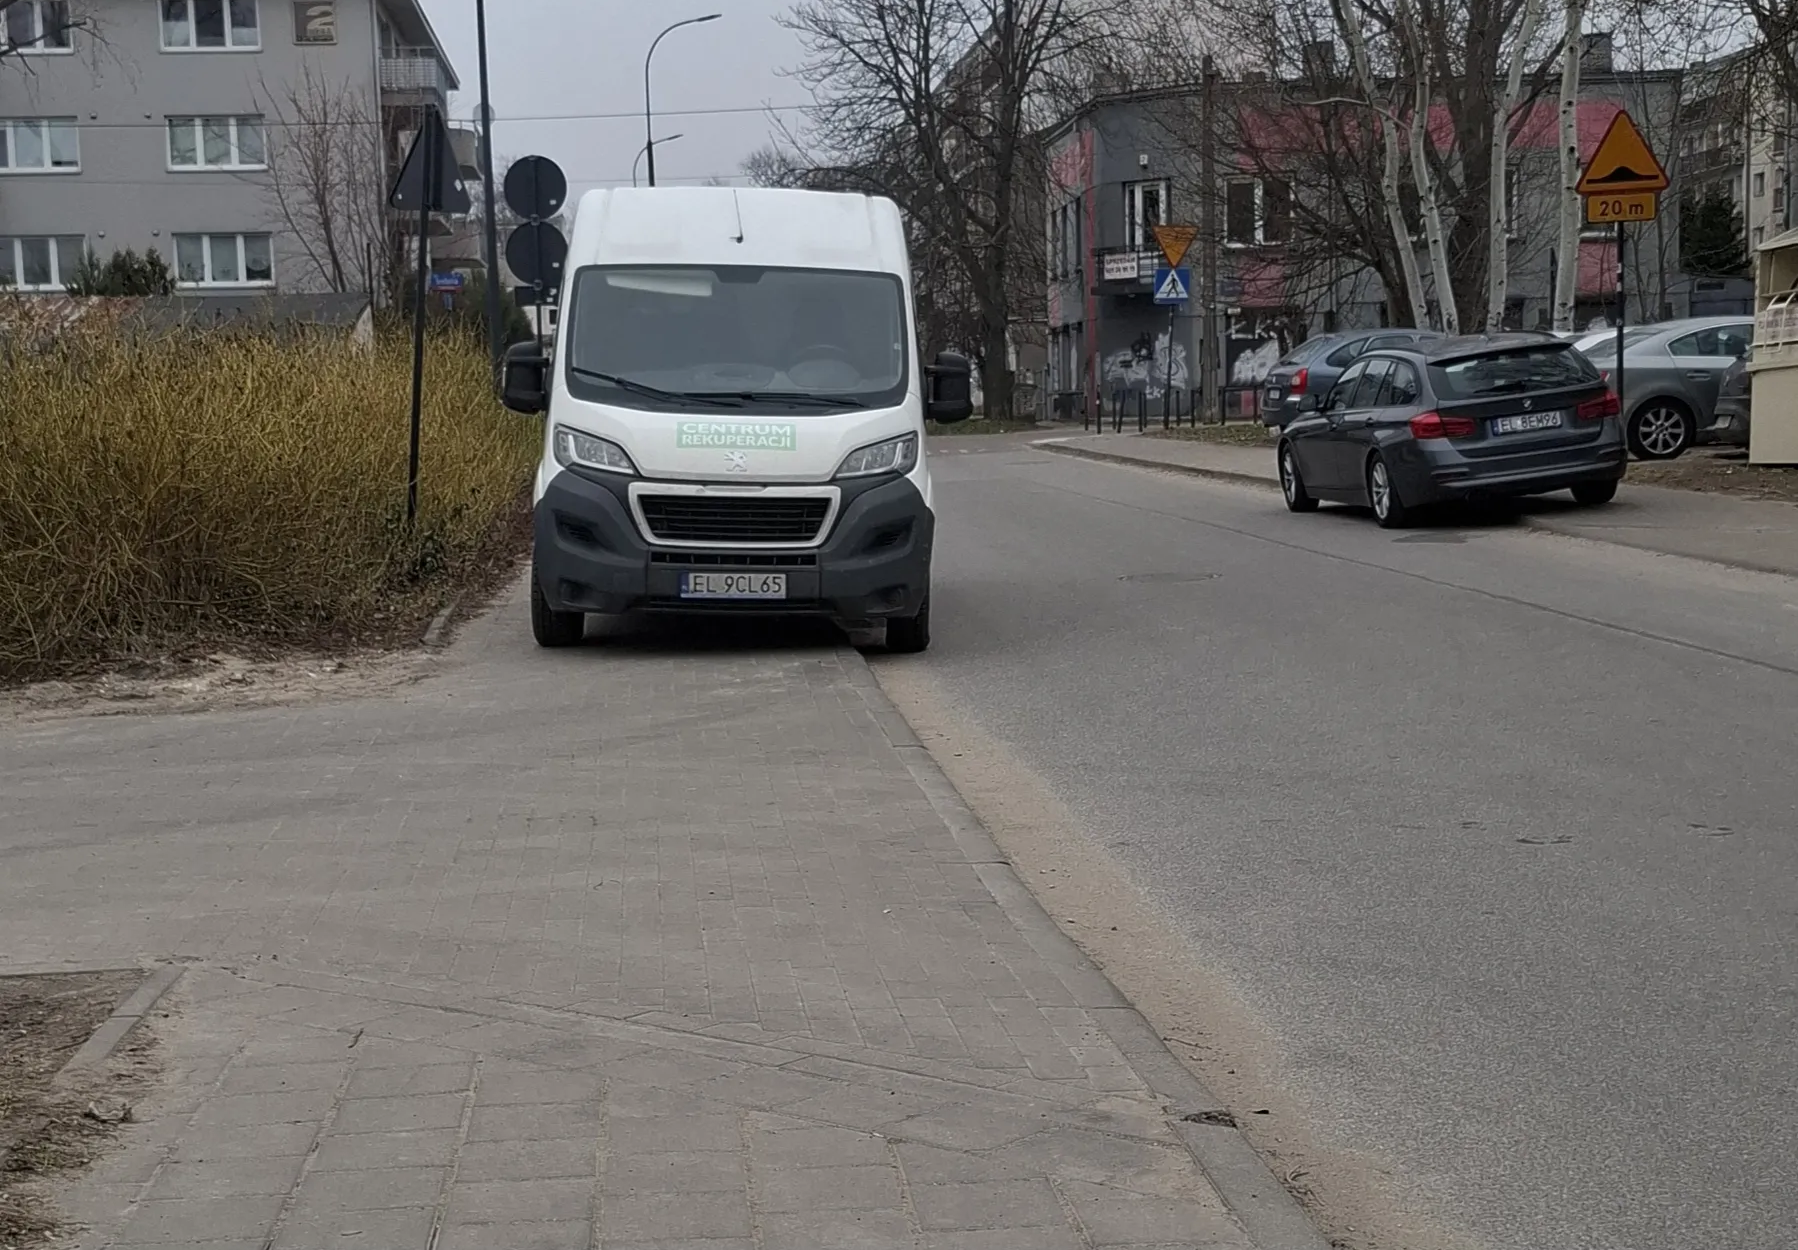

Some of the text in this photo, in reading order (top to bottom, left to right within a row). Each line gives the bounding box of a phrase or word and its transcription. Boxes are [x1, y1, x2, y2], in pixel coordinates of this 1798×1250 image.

[1599, 200, 1645, 216] 20 m
[682, 422, 791, 436] CENTRUM
[1500, 412, 1559, 433] EL 8EM96
[681, 434, 791, 448] REKUPERACJI
[693, 575, 783, 593] EL 9CL65
